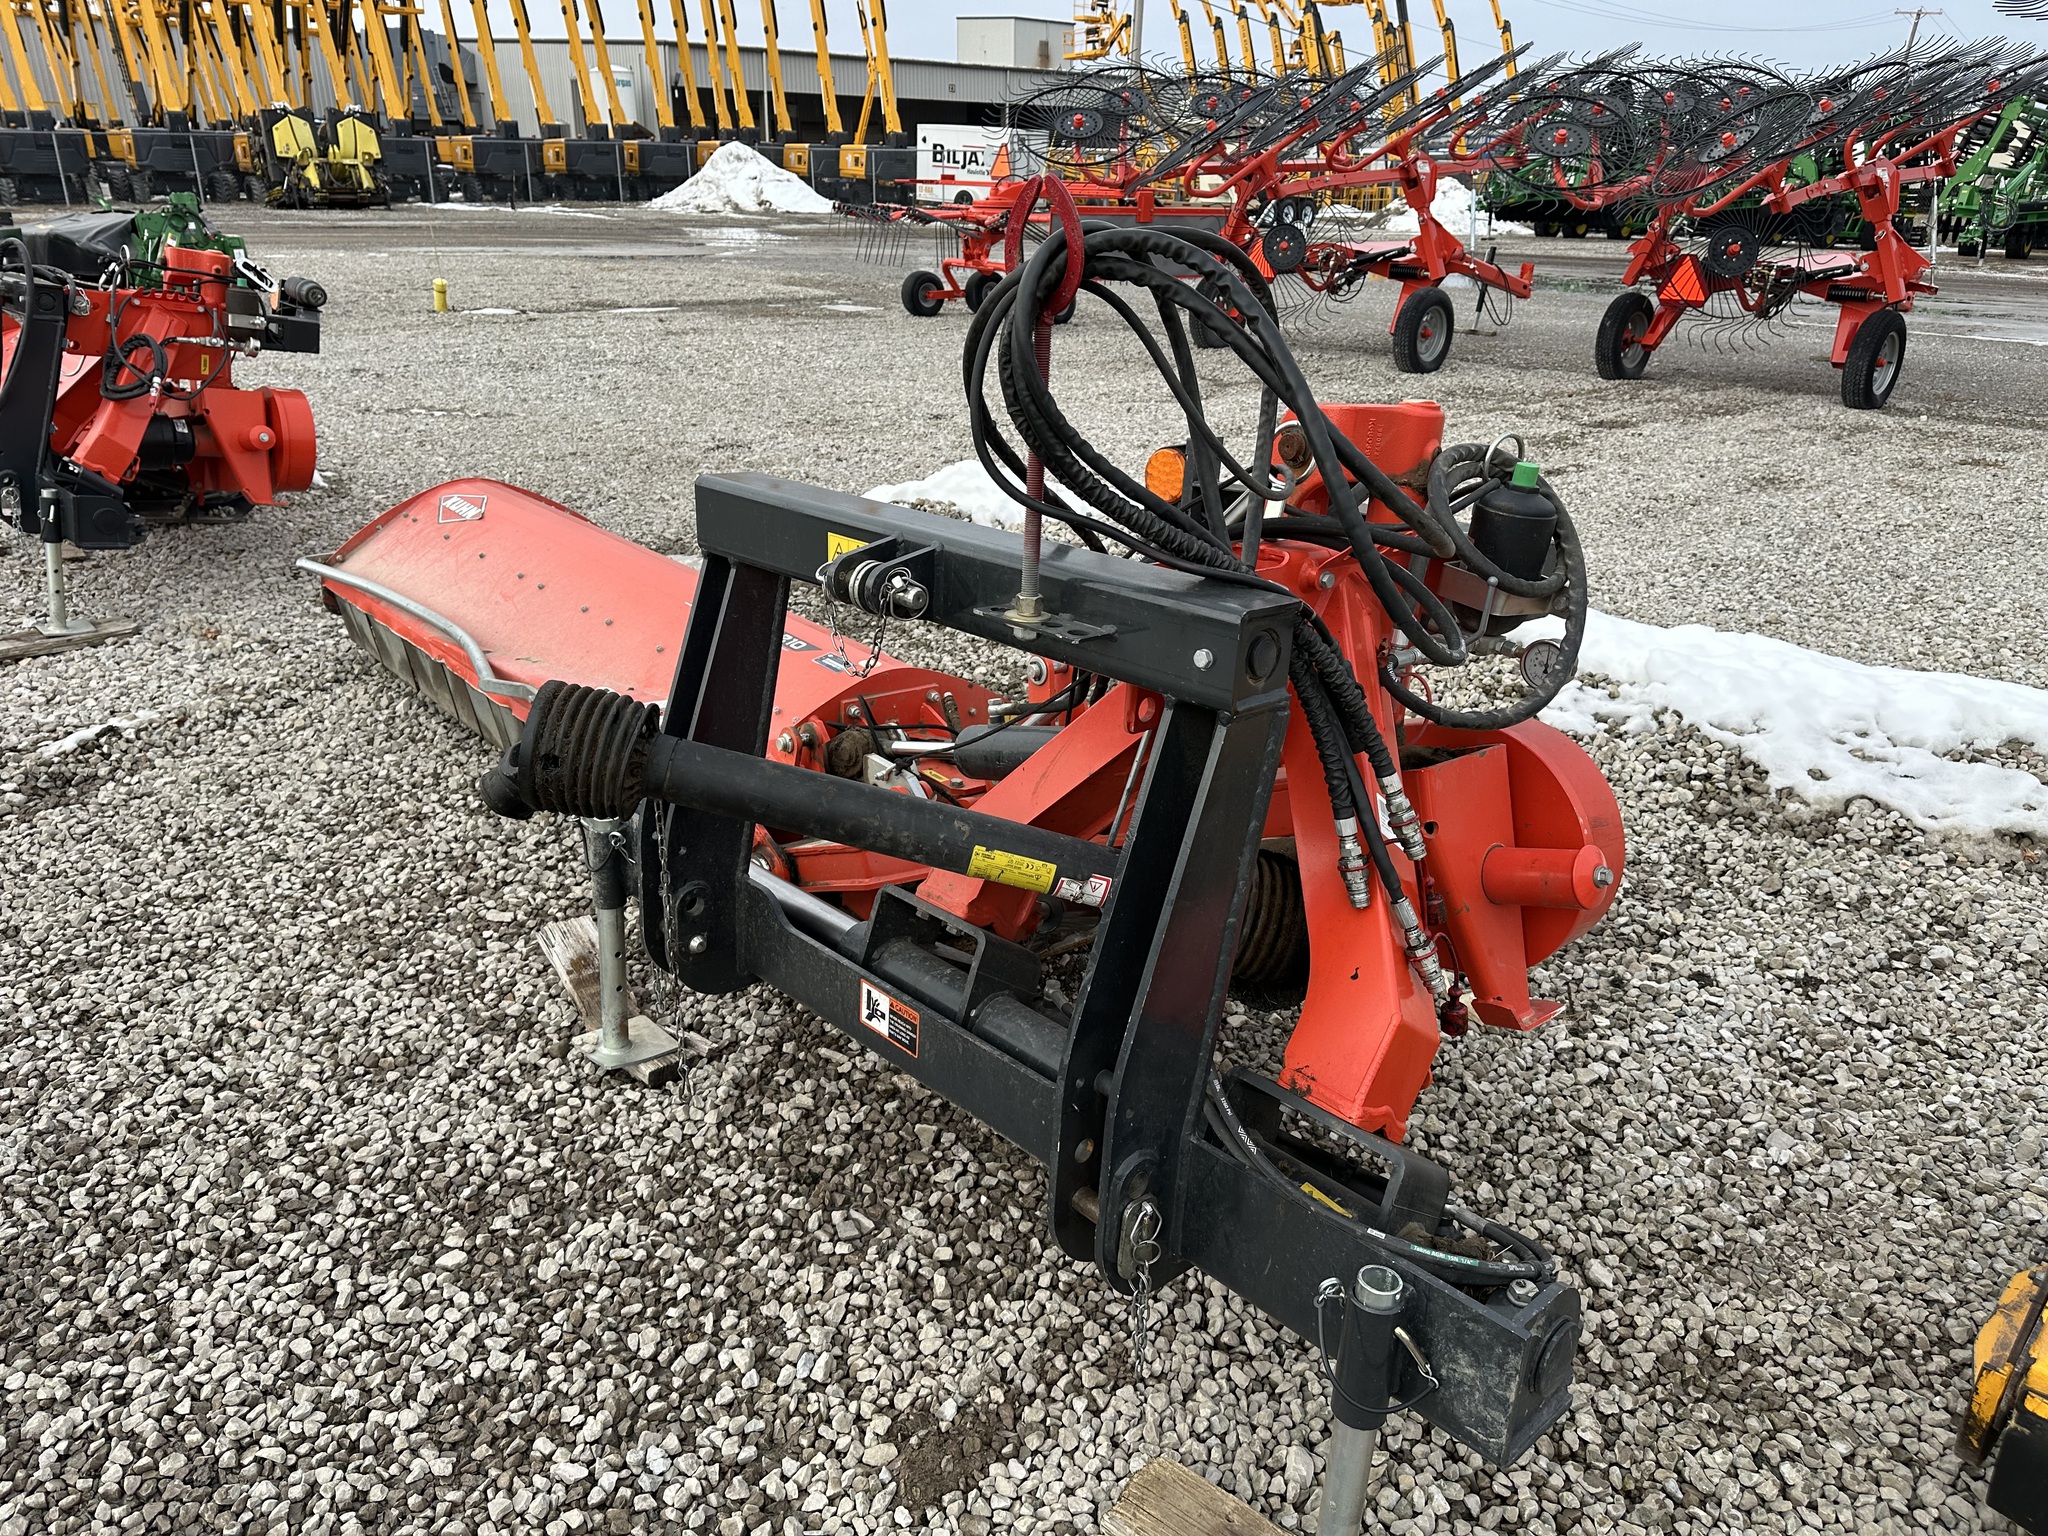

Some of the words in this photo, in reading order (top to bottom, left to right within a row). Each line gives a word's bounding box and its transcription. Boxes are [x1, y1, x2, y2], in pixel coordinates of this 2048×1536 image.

[615, 78, 631, 87] irgas
[932, 143, 985, 170] BILJA
[442, 496, 482, 519] KUHN
[895, 1003, 917, 1022] CAUTION
[1414, 1245, 1431, 1255] Tekno
[1431, 1250, 1446, 1259] AGRI
